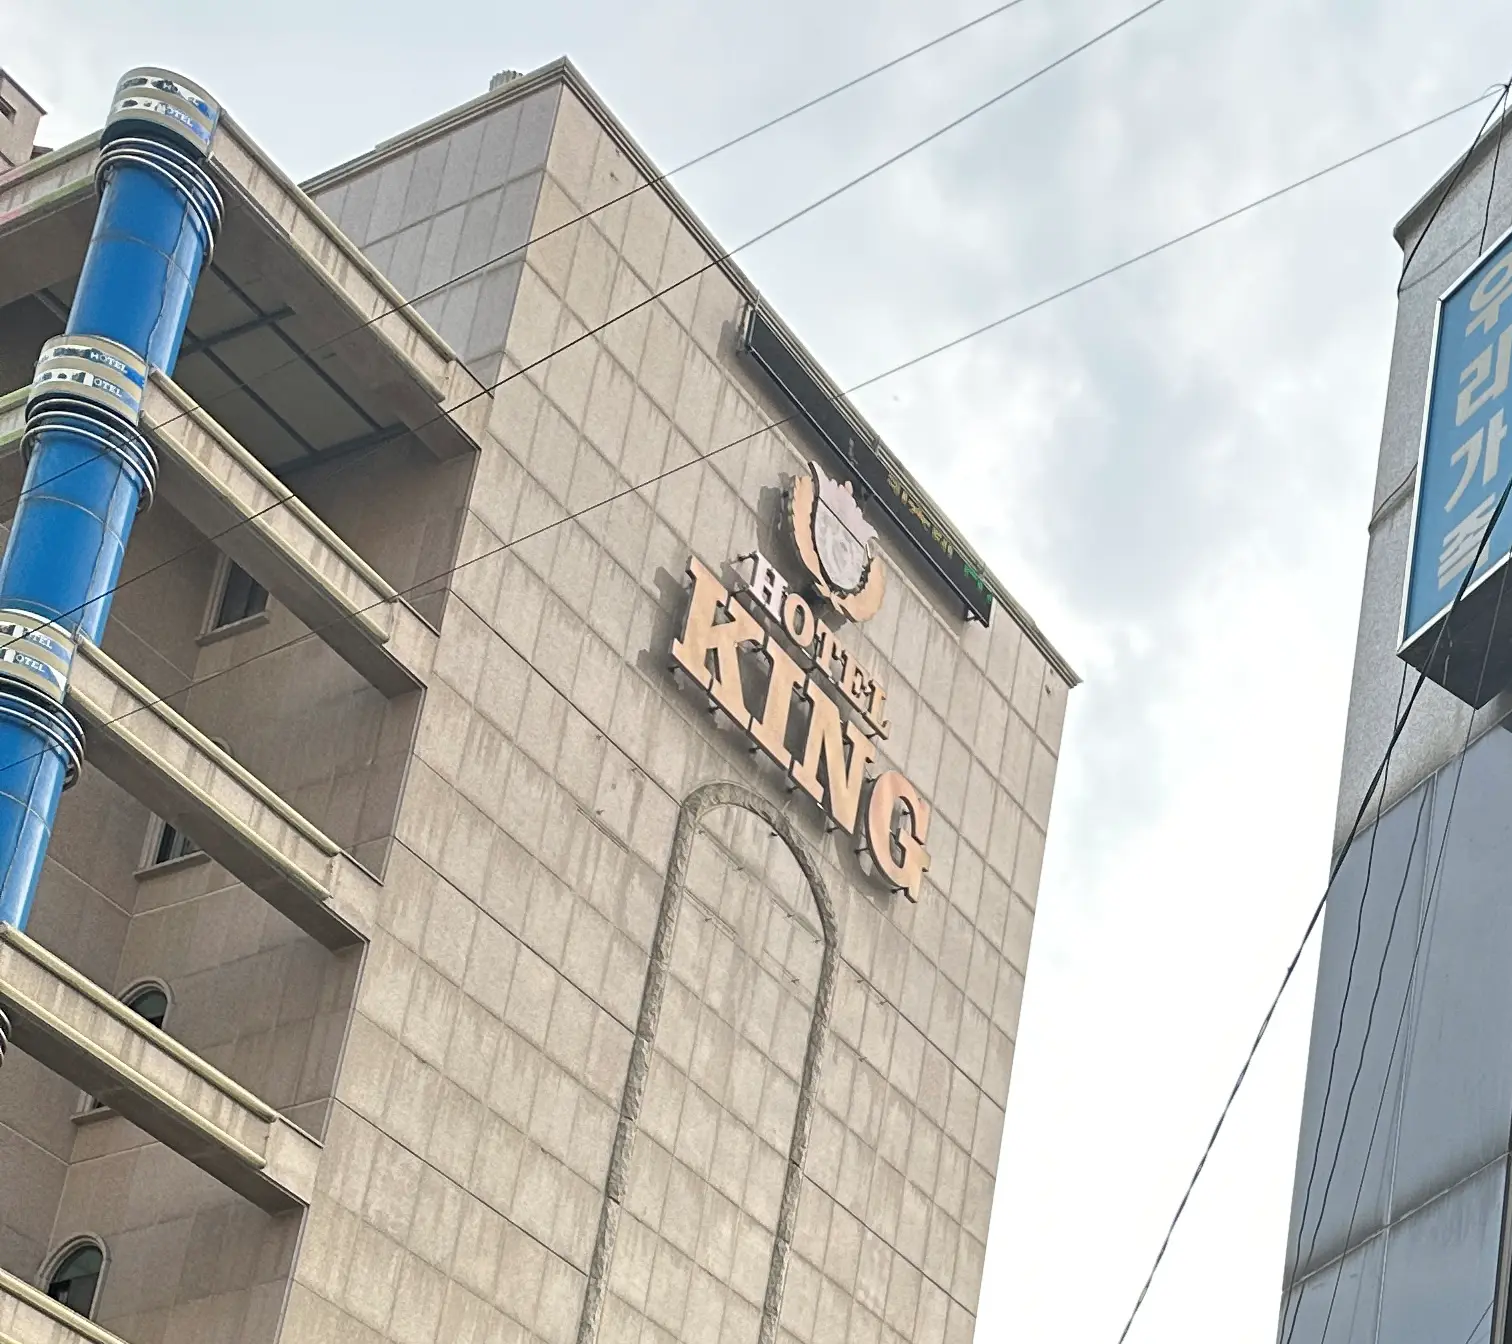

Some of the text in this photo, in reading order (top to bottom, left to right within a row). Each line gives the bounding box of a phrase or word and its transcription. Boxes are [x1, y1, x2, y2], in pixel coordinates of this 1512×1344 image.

[90, 376, 123, 398] OTEL
[671, 555, 932, 905] KING
[728, 550, 892, 741] HOTEL
